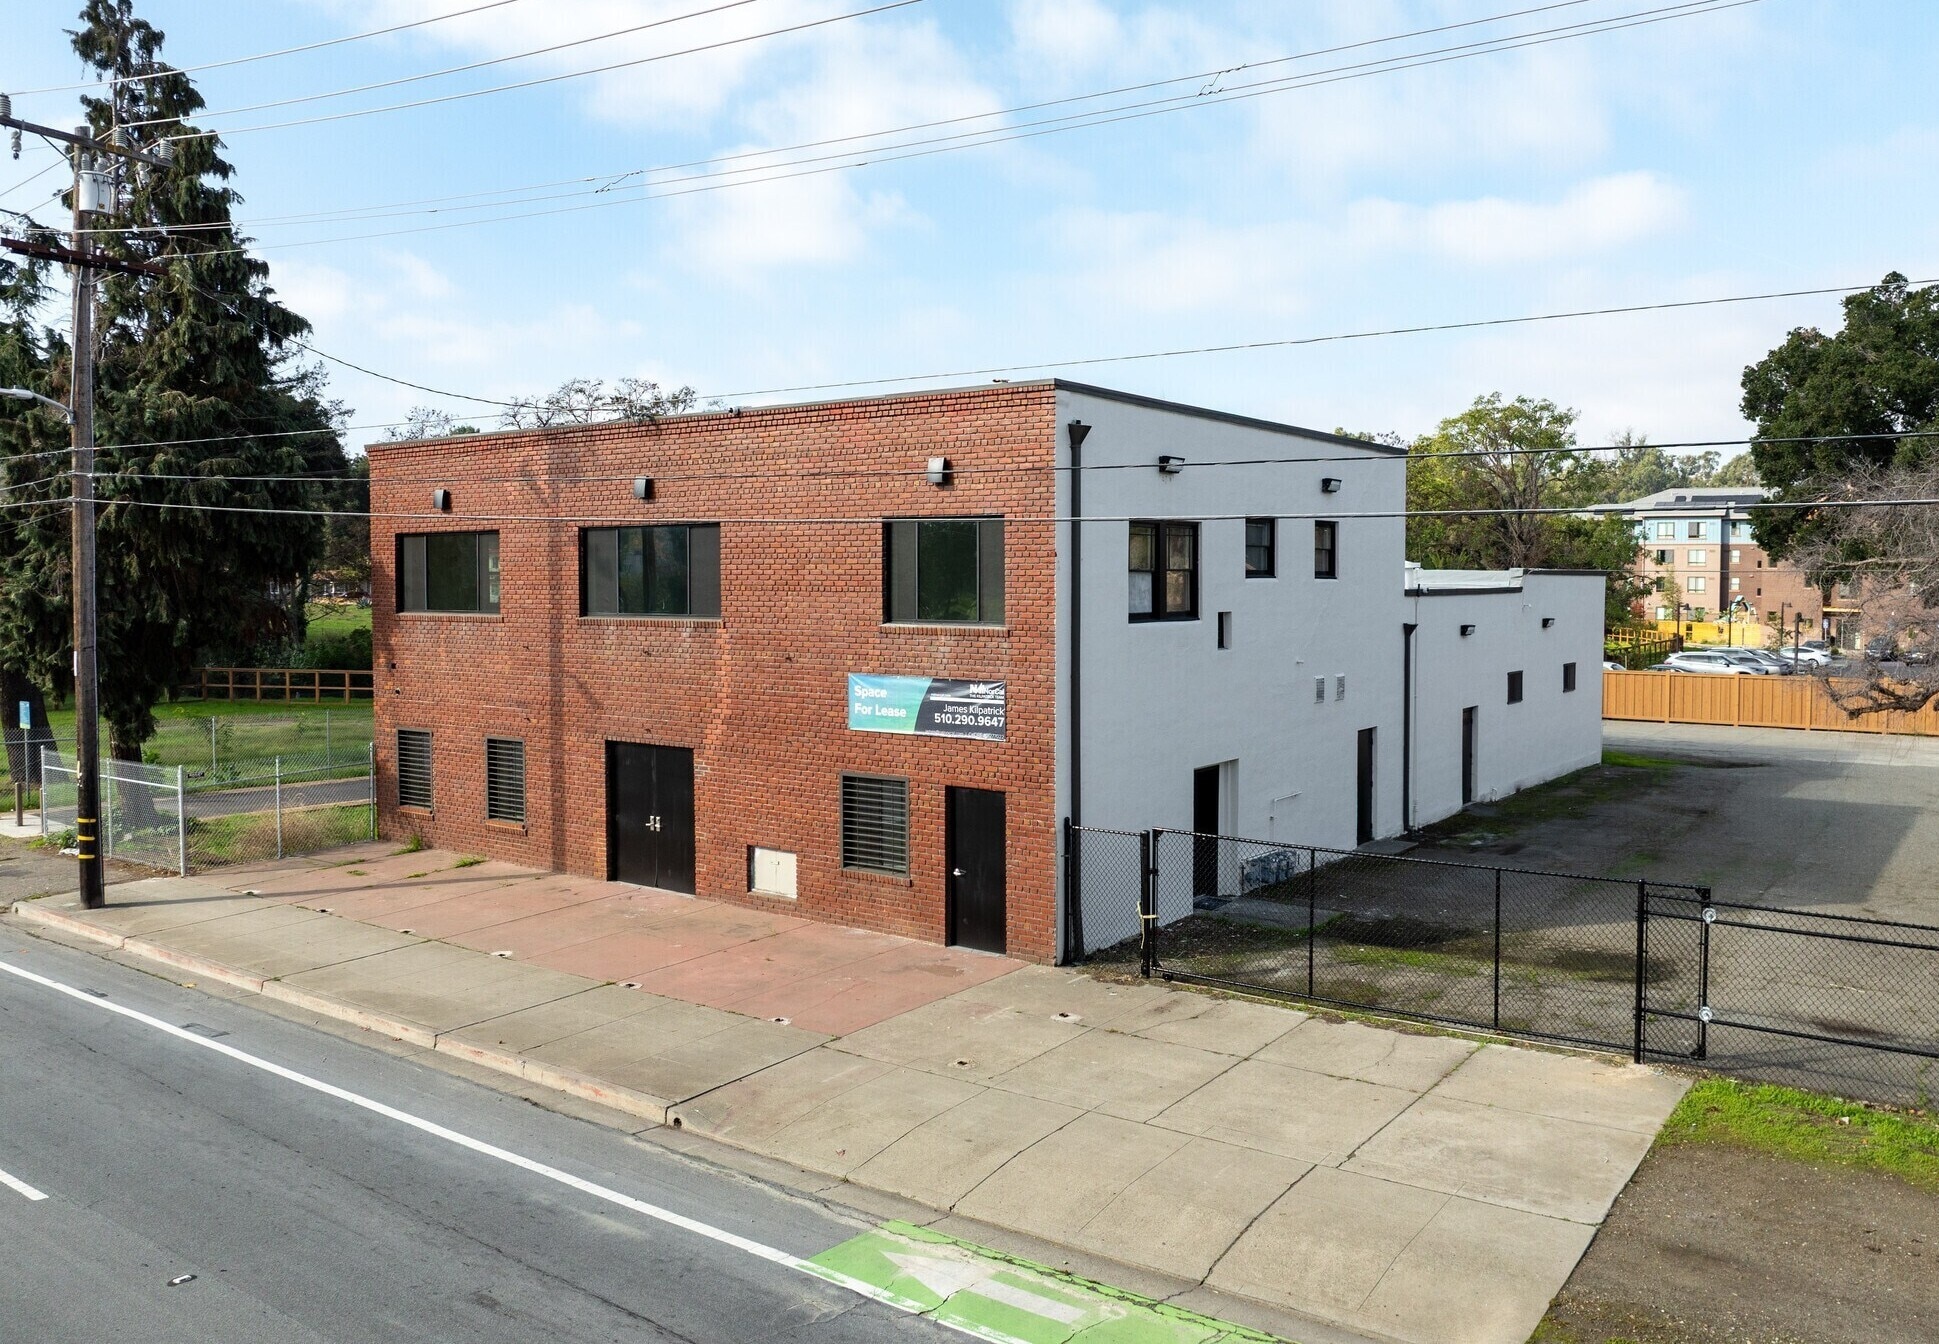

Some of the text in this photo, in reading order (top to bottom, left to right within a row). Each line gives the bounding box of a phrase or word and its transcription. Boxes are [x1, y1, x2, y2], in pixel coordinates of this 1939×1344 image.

[854, 685, 887, 699] Space
[854, 702, 907, 718] For Lease
[943, 704, 1005, 716] James Kilpatrick
[934, 712, 1005, 727] 510.290.9647
